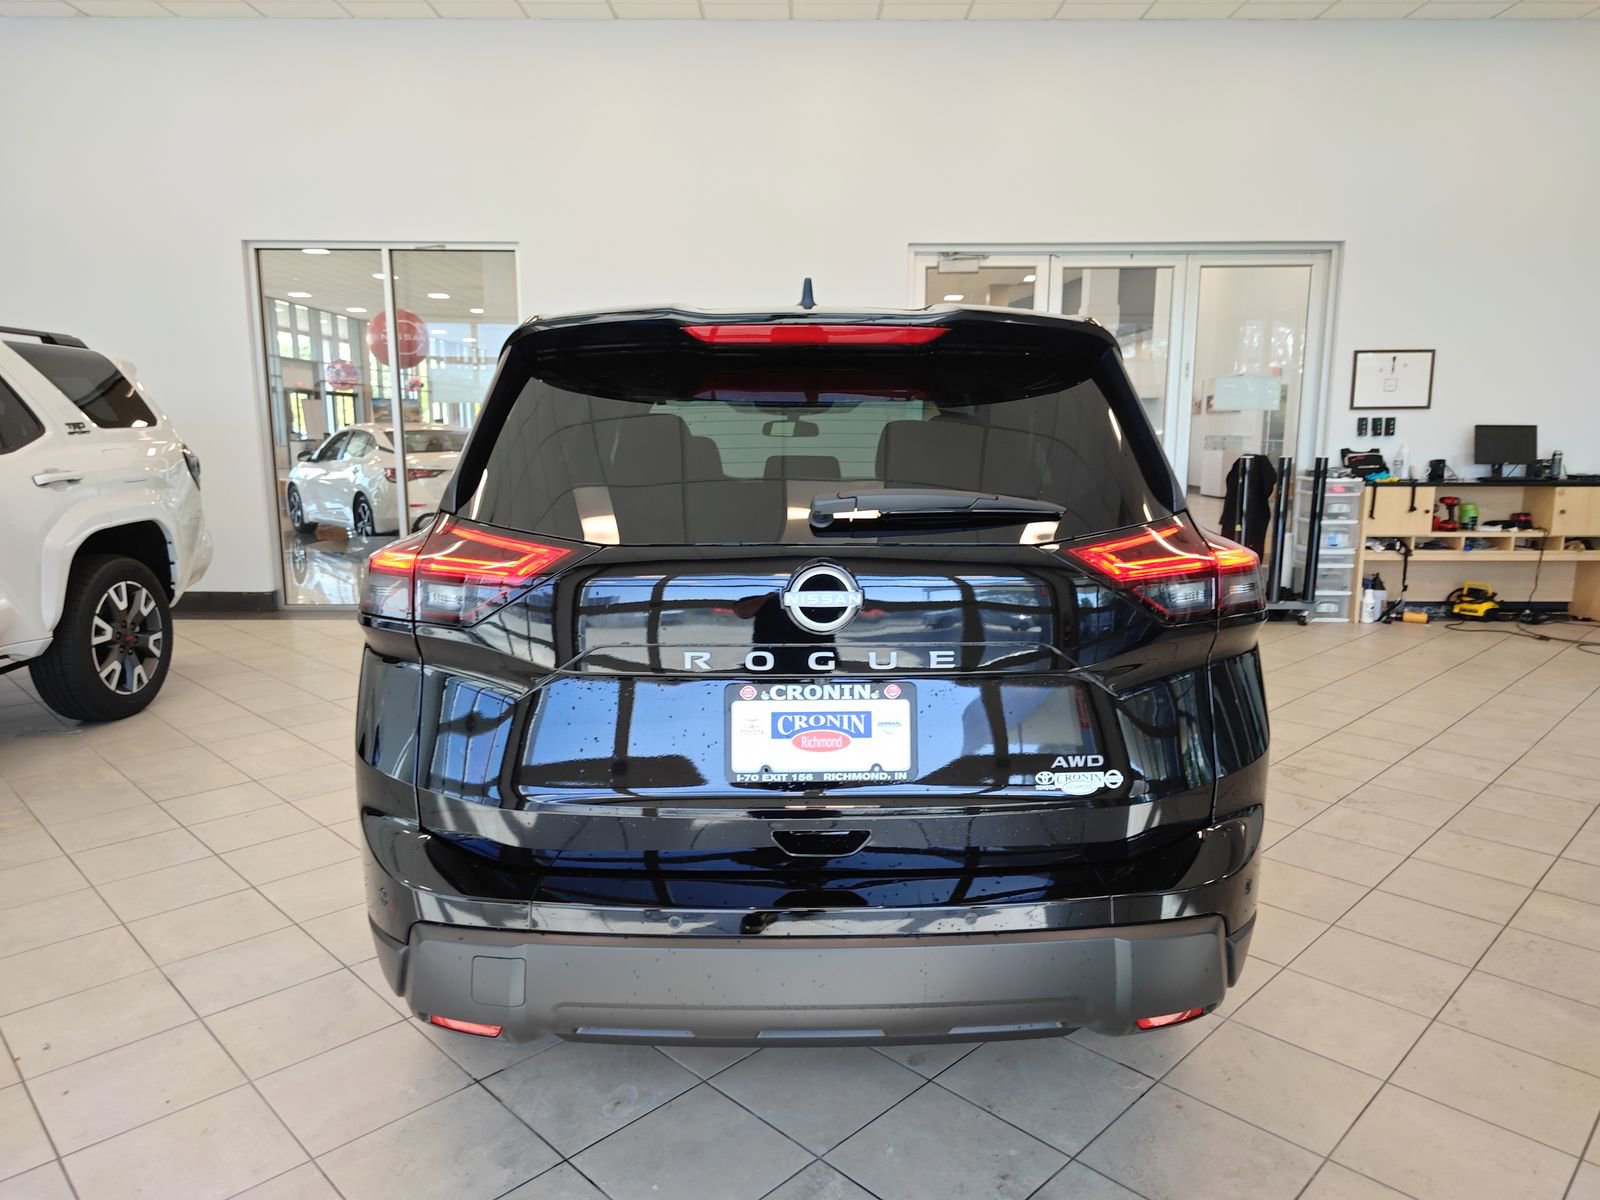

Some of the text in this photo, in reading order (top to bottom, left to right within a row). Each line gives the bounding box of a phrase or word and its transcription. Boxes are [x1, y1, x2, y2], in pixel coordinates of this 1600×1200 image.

[786, 594, 861, 605] NISSAN
[683, 650, 956, 671] ROGUE
[769, 684, 871, 700] CRONIN
[777, 713, 866, 735] CRONIN
[801, 735, 843, 748] Richmond
[1050, 755, 1104, 769] AWD
[736, 773, 813, 782] I-70 EXIT 156
[823, 772, 908, 781] RICHMOND, IN
[1057, 773, 1102, 785] CRONIN
